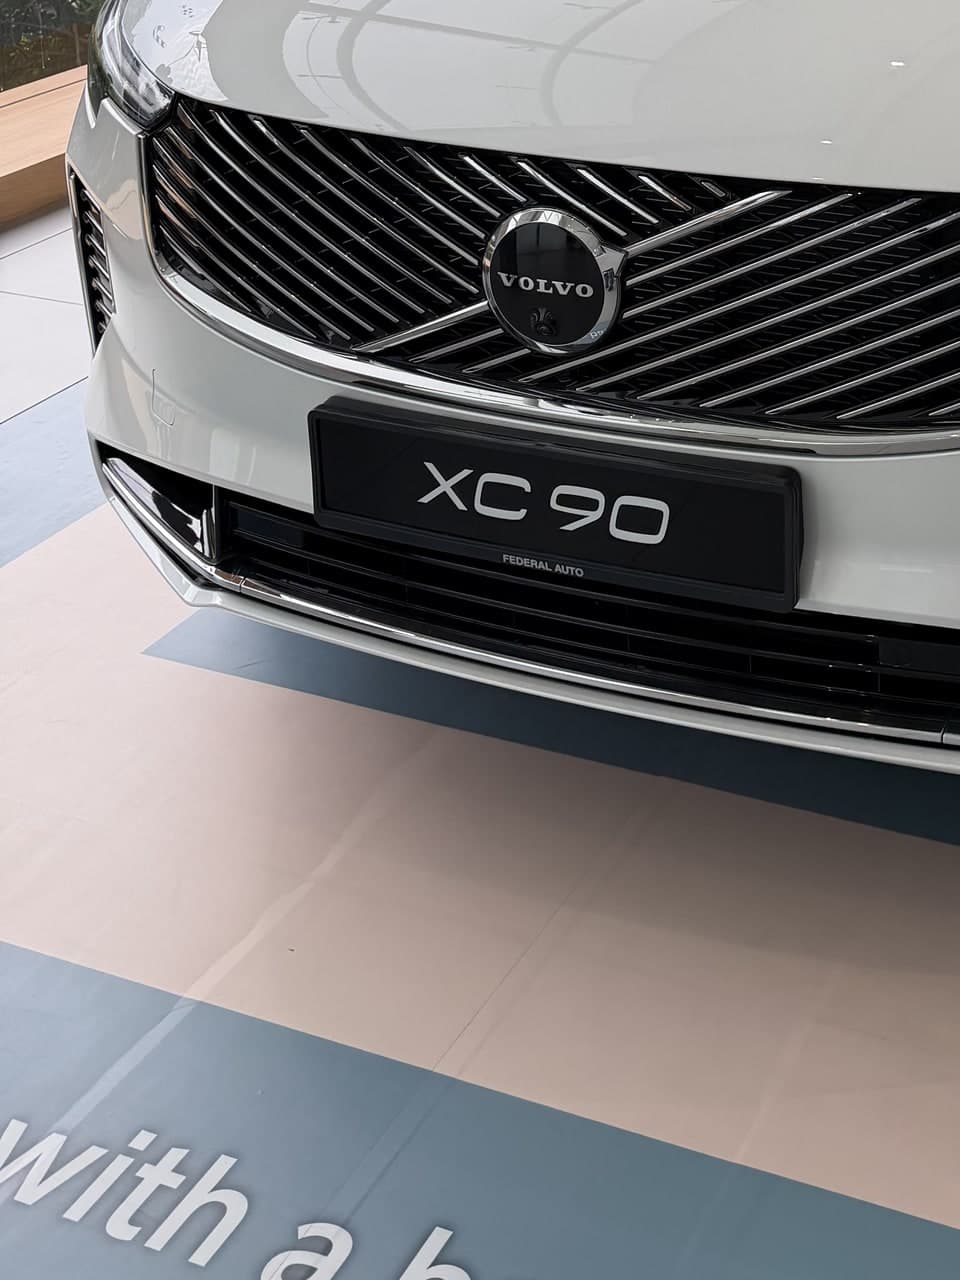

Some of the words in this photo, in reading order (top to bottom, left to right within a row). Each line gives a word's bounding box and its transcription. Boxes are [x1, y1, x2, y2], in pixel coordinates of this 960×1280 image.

[497, 271, 594, 298] VOLVO
[417, 461, 531, 521] XC
[549, 484, 671, 546] 90
[502, 554, 552, 571] FEDERAL
[553, 563, 584, 577] AUTO
[0, 1119, 249, 1268] with
[260, 1222, 353, 1280] a
